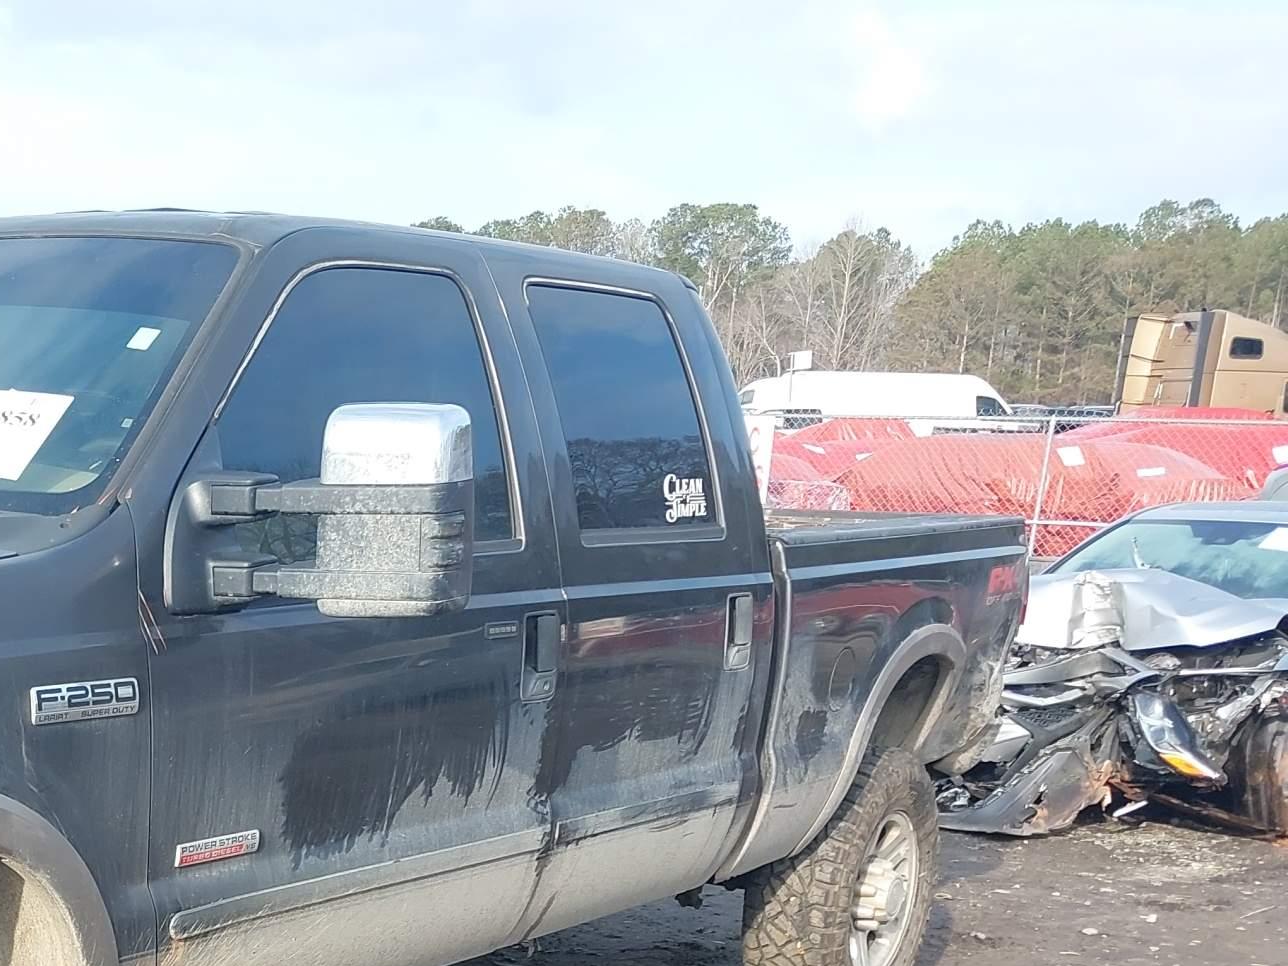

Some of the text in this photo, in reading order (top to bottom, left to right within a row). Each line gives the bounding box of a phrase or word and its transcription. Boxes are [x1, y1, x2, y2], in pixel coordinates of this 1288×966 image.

[664, 474, 703, 500] CLEAN
[38, 705, 135, 722] LARIAT SUPER DUTY
[181, 832, 257, 853] POWER STROKE
[182, 852, 210, 863] TURBO
[212, 846, 242, 857] DIESEL
